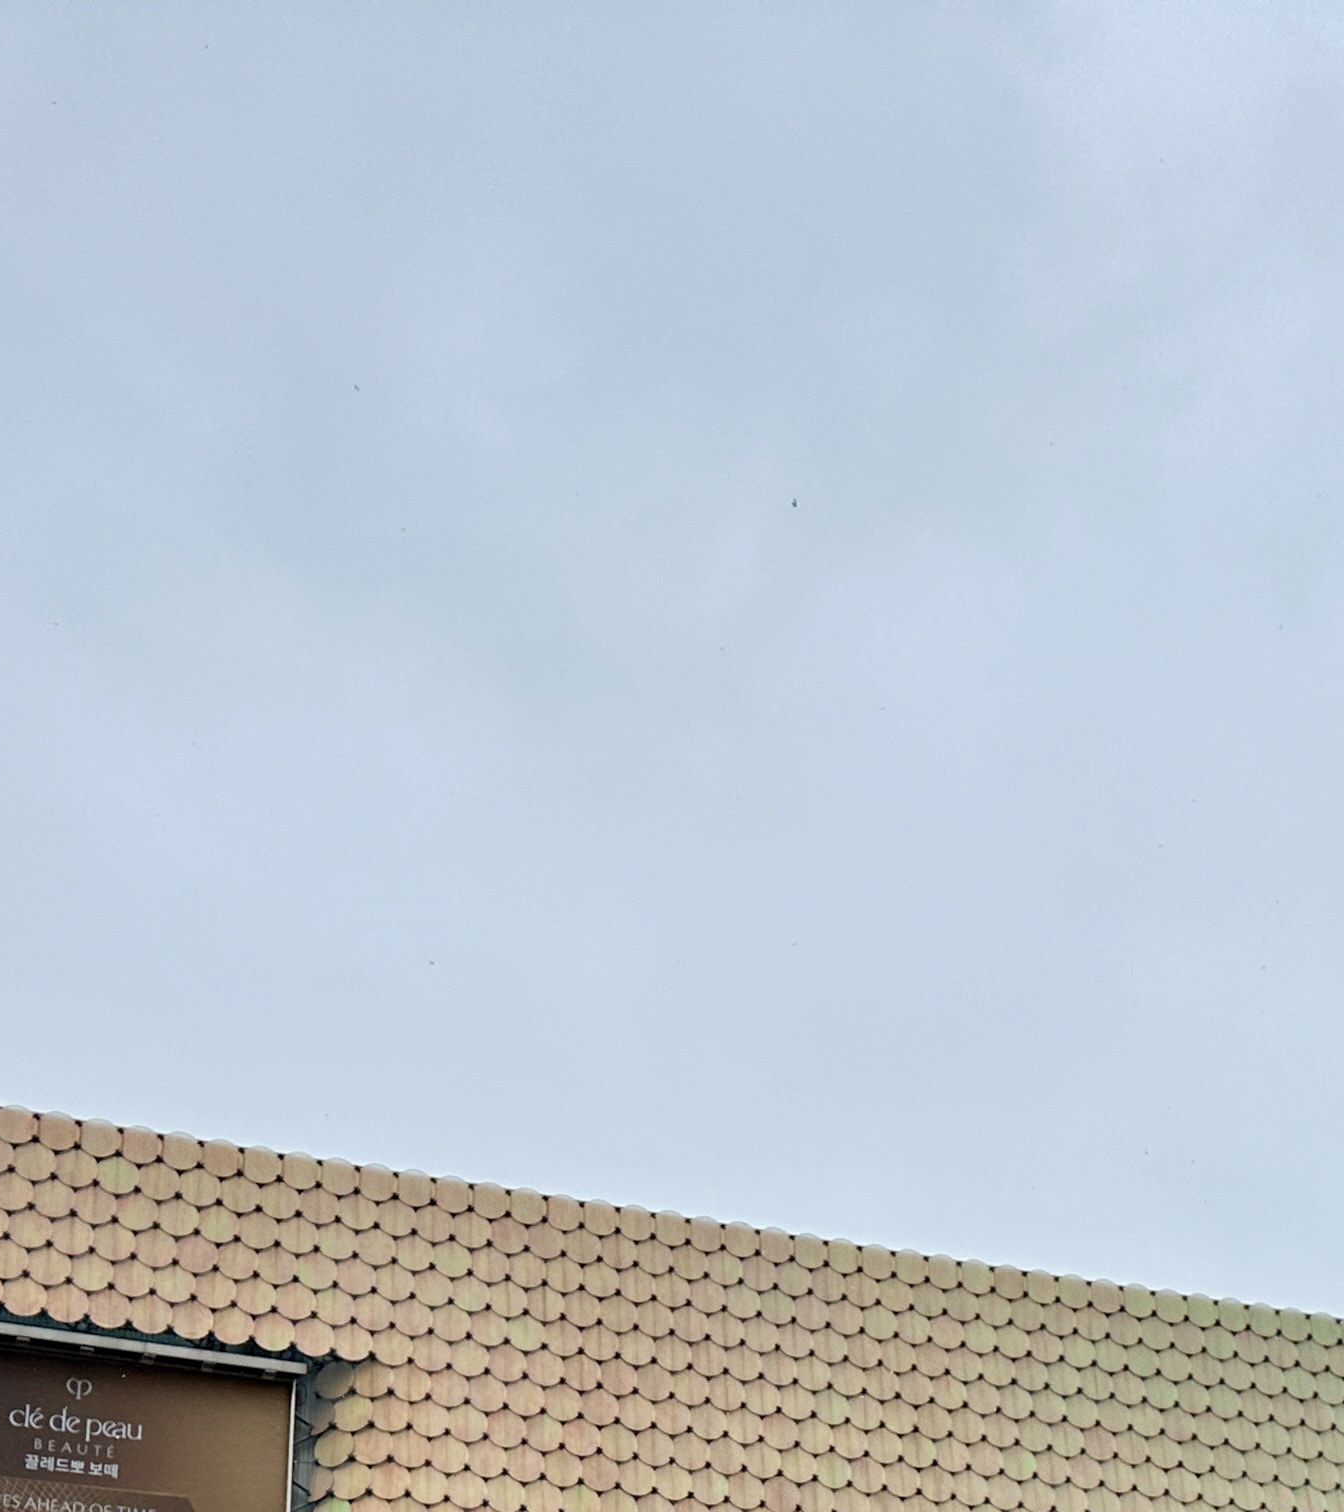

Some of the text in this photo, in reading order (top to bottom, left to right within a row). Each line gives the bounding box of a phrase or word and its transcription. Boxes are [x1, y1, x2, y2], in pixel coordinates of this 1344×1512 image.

[9, 1403, 142, 1442] clé de peau
[33, 1437, 115, 1459] BEAUTÉ
